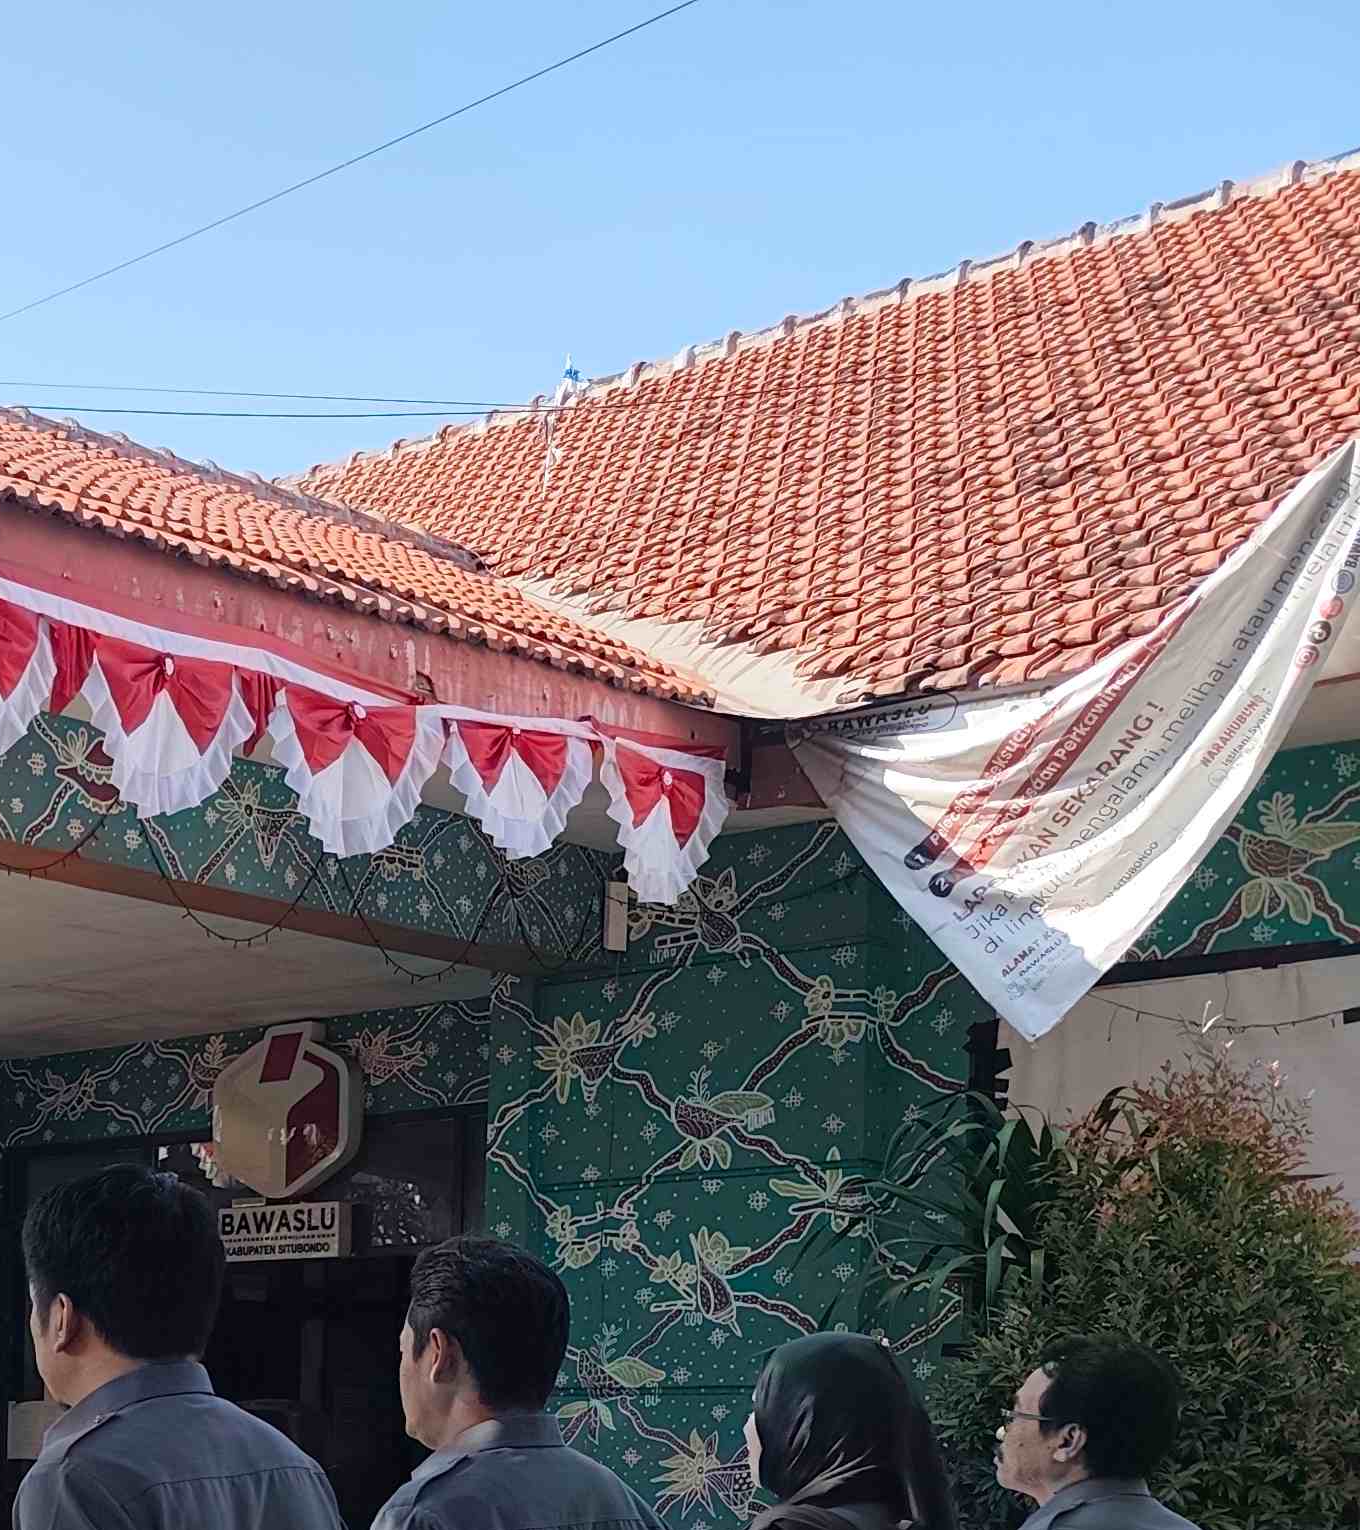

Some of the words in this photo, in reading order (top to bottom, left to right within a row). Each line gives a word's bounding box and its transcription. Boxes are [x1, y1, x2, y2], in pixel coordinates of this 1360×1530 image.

[1201, 694, 1266, 768] NARAHUBUNG
[966, 903, 1009, 940] Jika
[1232, 599, 1274, 652] atau
[953, 827, 1060, 922] LAPOKAN
[1053, 713, 1154, 828] SEKARANG
[935, 877, 949, 893] 2
[984, 931, 1006, 954] di
[222, 1207, 335, 1235] BAWASLU
[227, 1244, 275, 1257] KABUPATEN
[278, 1242, 330, 1255] SITUBONDO
